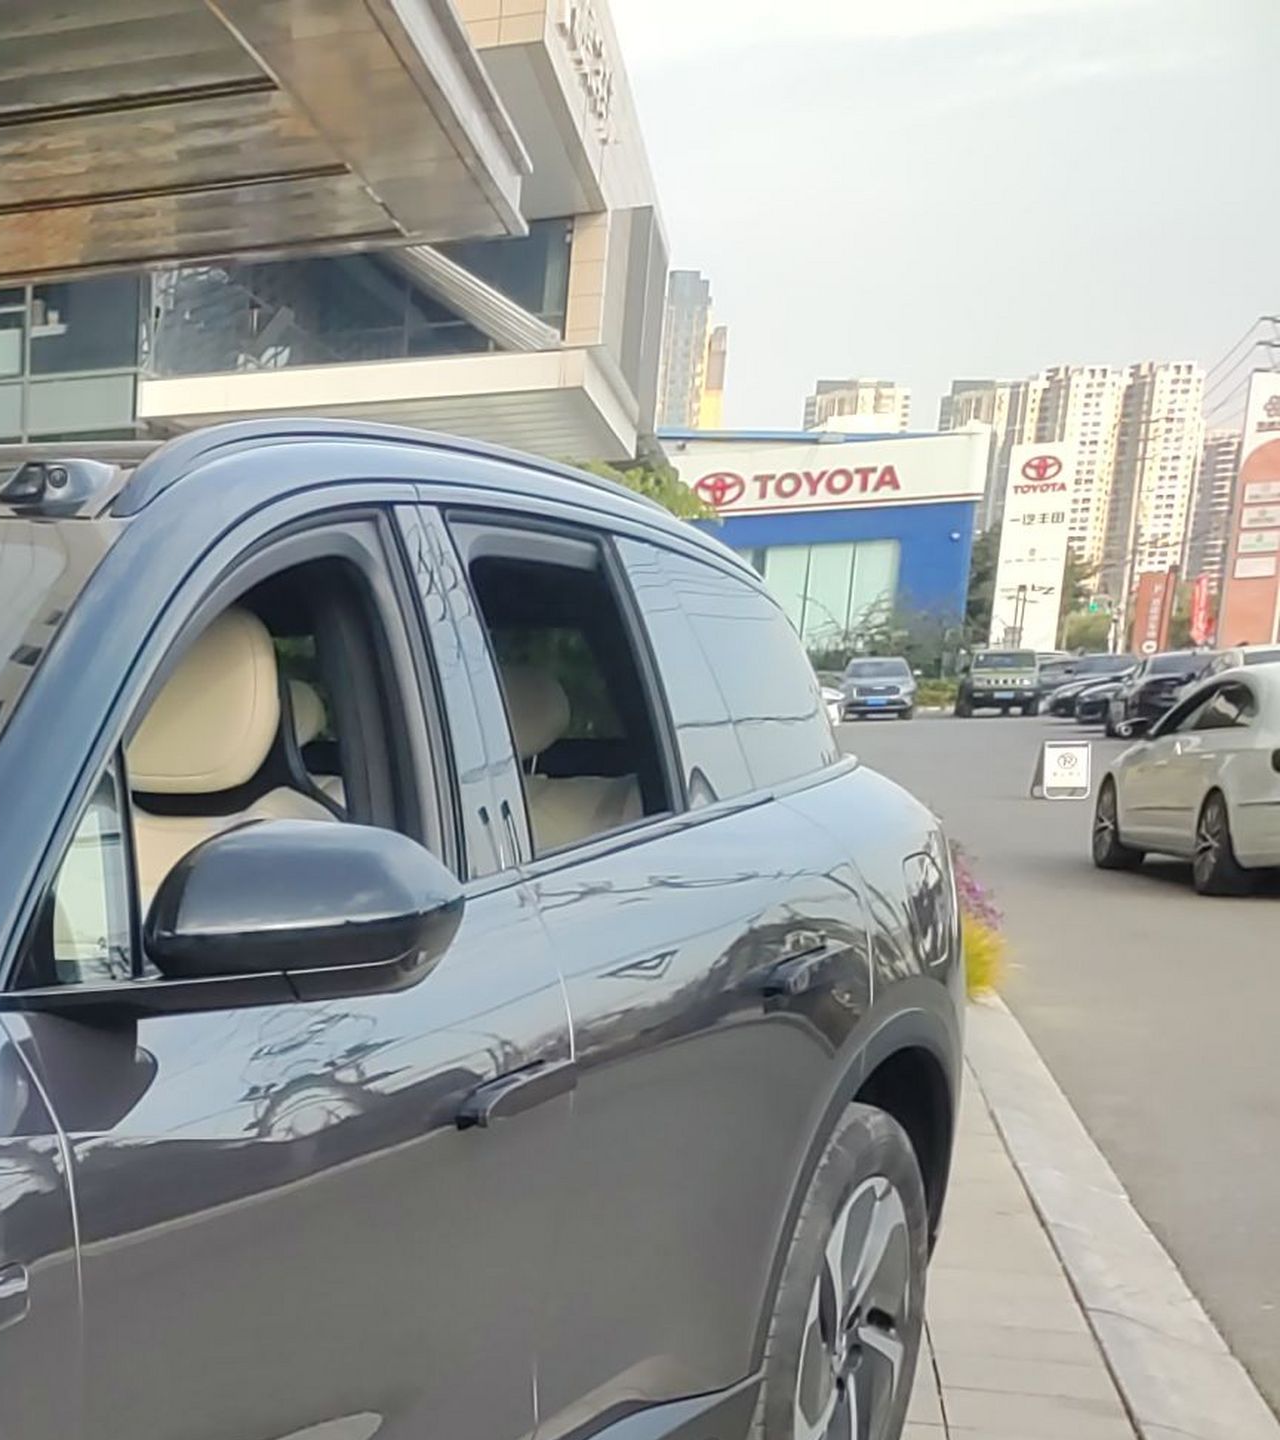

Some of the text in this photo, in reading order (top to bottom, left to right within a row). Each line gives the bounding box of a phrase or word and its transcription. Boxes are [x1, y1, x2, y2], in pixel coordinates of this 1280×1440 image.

[752, 464, 901, 500] TOYOTA
[1013, 482, 1067, 495] TOYOTA
[1009, 511, 1065, 526] 一汽丰田
